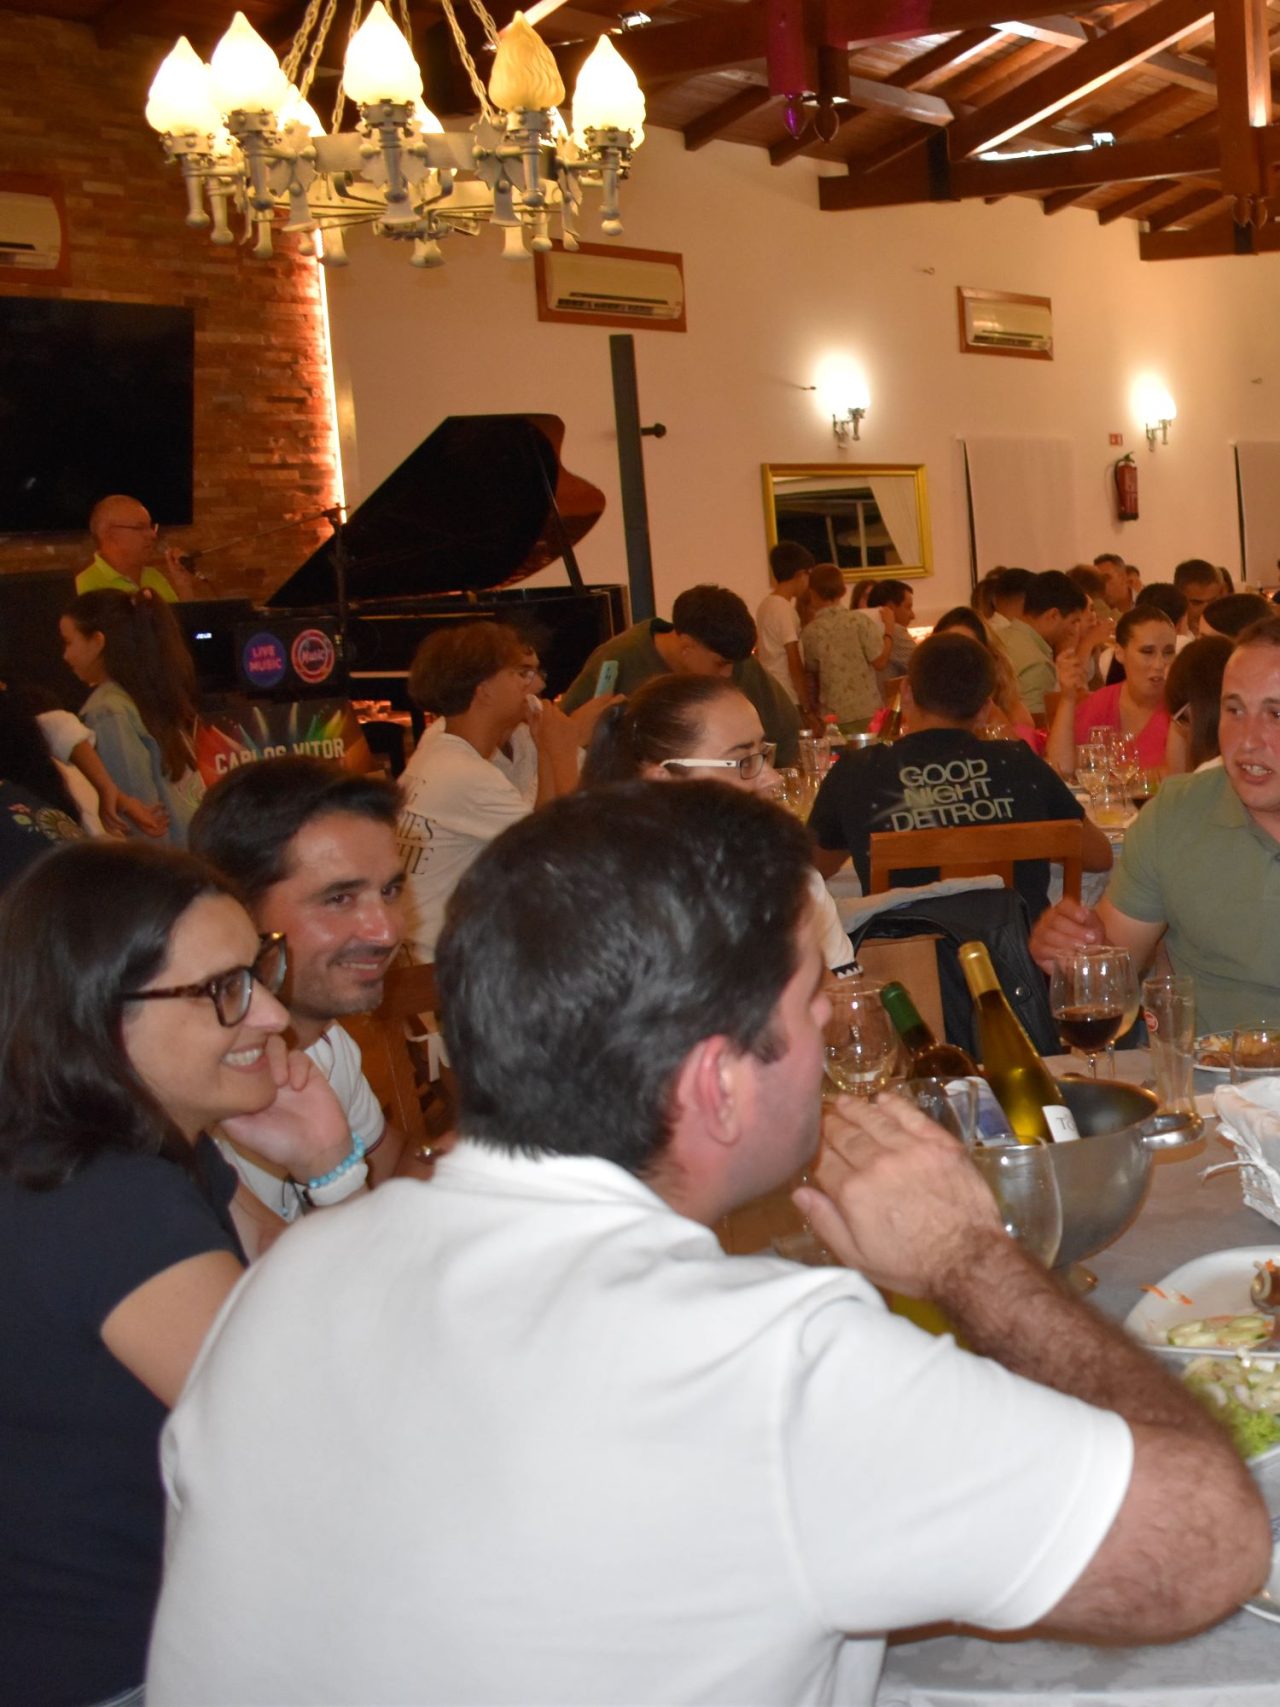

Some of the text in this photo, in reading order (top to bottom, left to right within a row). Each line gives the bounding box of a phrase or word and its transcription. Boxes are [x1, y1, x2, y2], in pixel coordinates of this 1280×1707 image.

[252, 645, 276, 657] LIVE
[293, 738, 345, 759] VITOR
[899, 758, 989, 787] GOOD
[903, 777, 992, 807] NIGHT
[890, 797, 1015, 832] DETROIT
